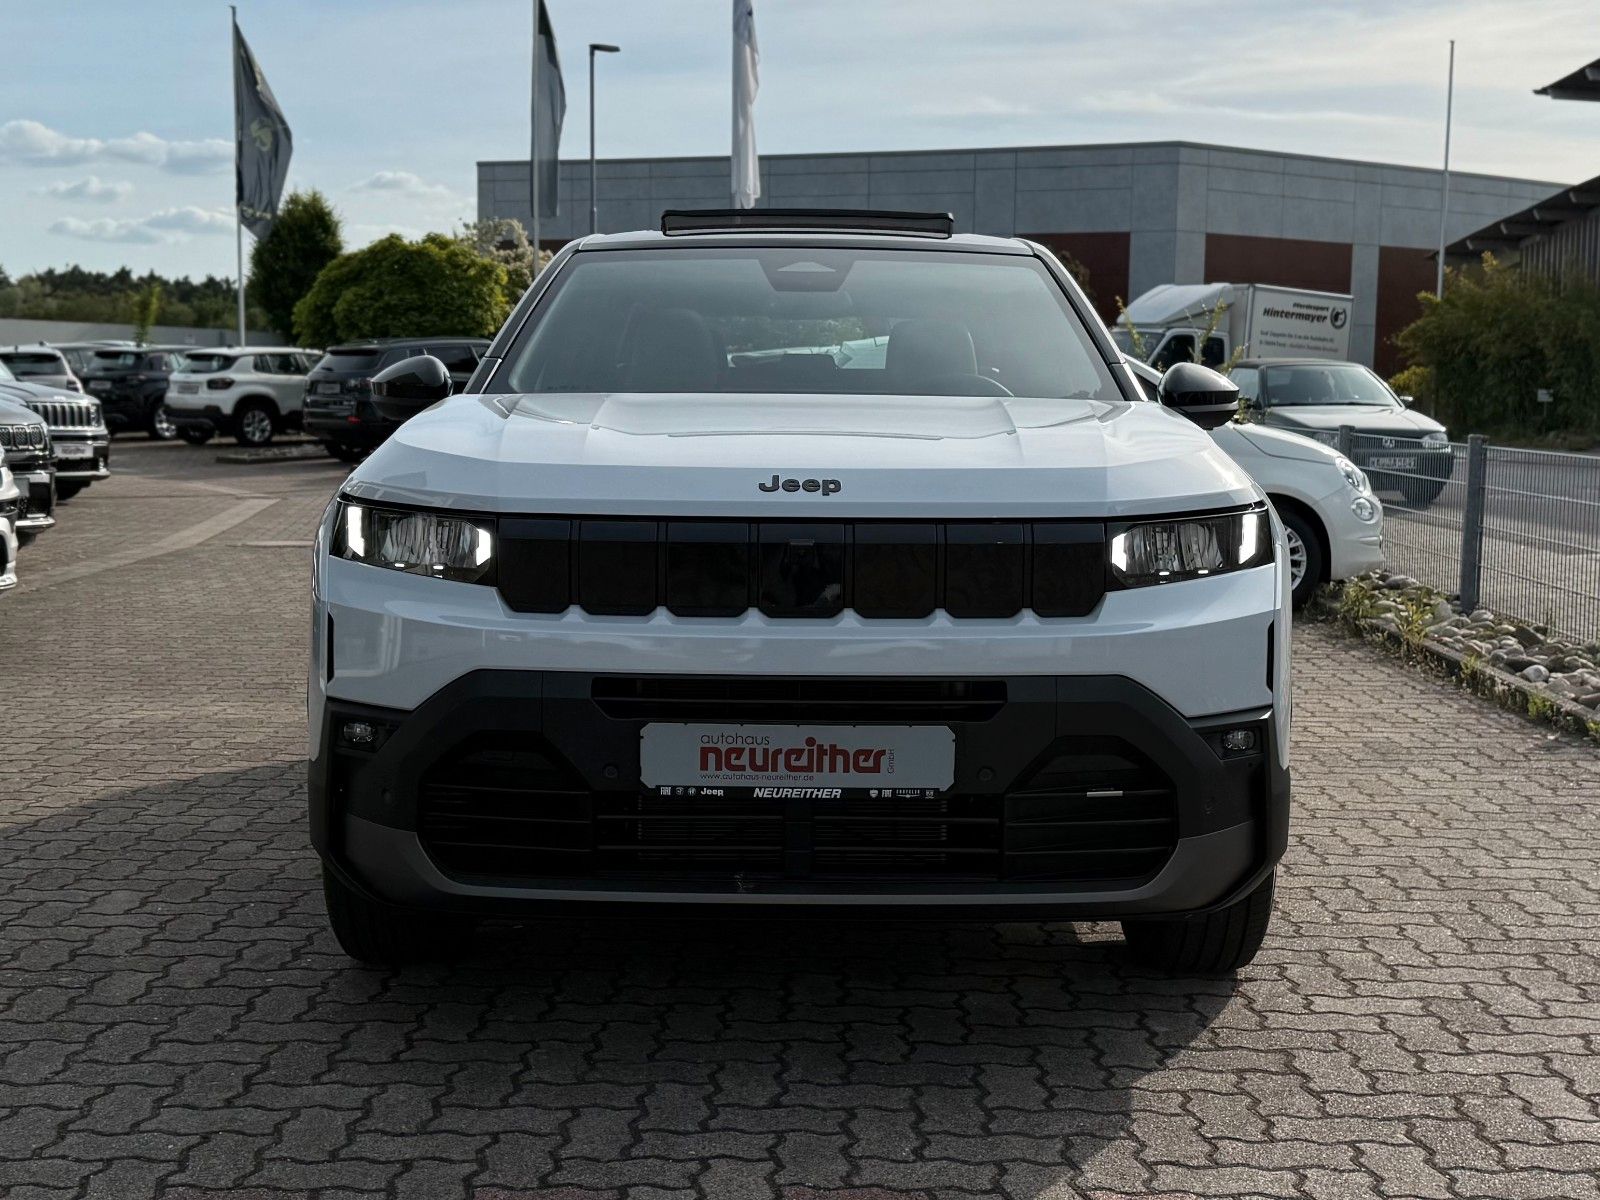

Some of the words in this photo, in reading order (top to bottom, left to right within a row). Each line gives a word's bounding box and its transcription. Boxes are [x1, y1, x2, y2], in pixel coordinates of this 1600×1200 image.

[1263, 307, 1327, 323] Hintermayer
[759, 475, 841, 496] Jeep
[701, 732, 770, 746] autohaus
[700, 737, 886, 773] neureither
[753, 788, 842, 799] NEUREITHER
